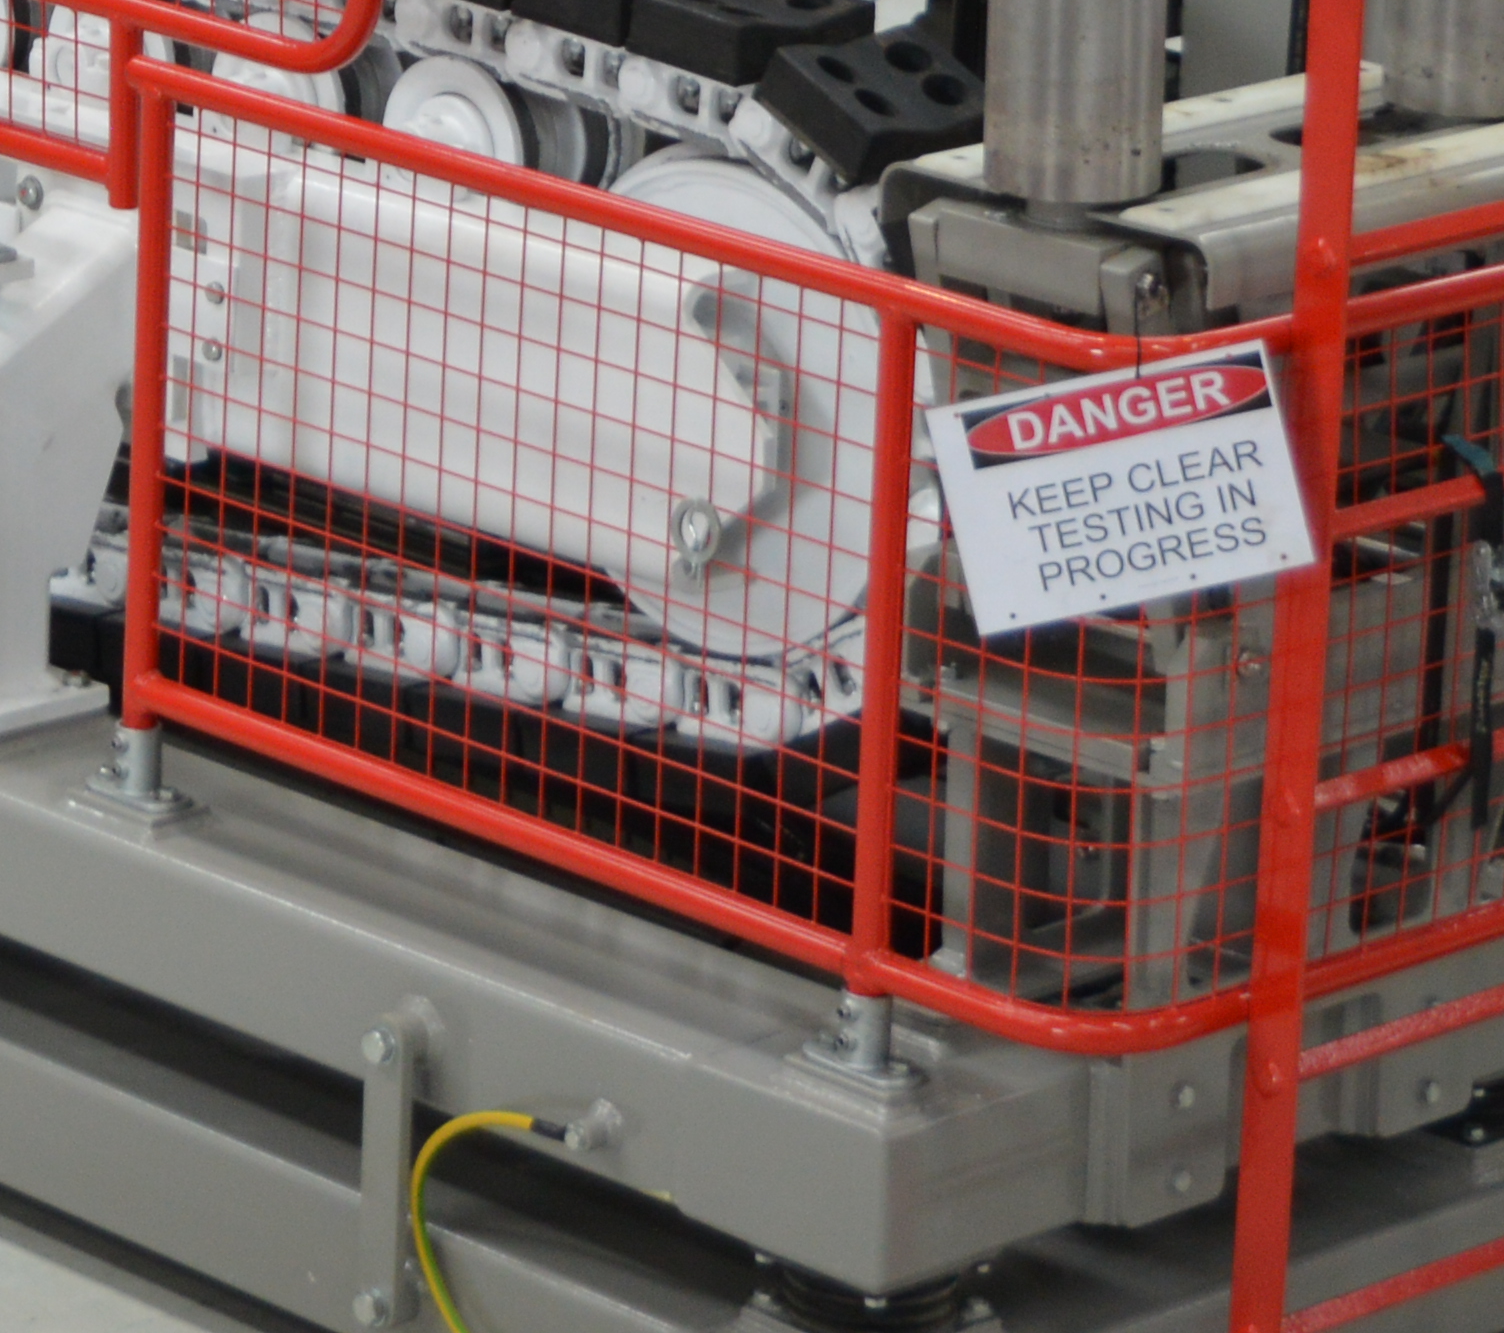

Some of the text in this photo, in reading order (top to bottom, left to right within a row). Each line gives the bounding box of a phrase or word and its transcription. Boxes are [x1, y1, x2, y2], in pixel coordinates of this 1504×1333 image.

[1006, 369, 1231, 451] DANGER
[1008, 439, 1263, 520] KEEP CLEAR
[1028, 479, 1257, 553] TESTING IN
[1038, 516, 1267, 591] PROGRESS
